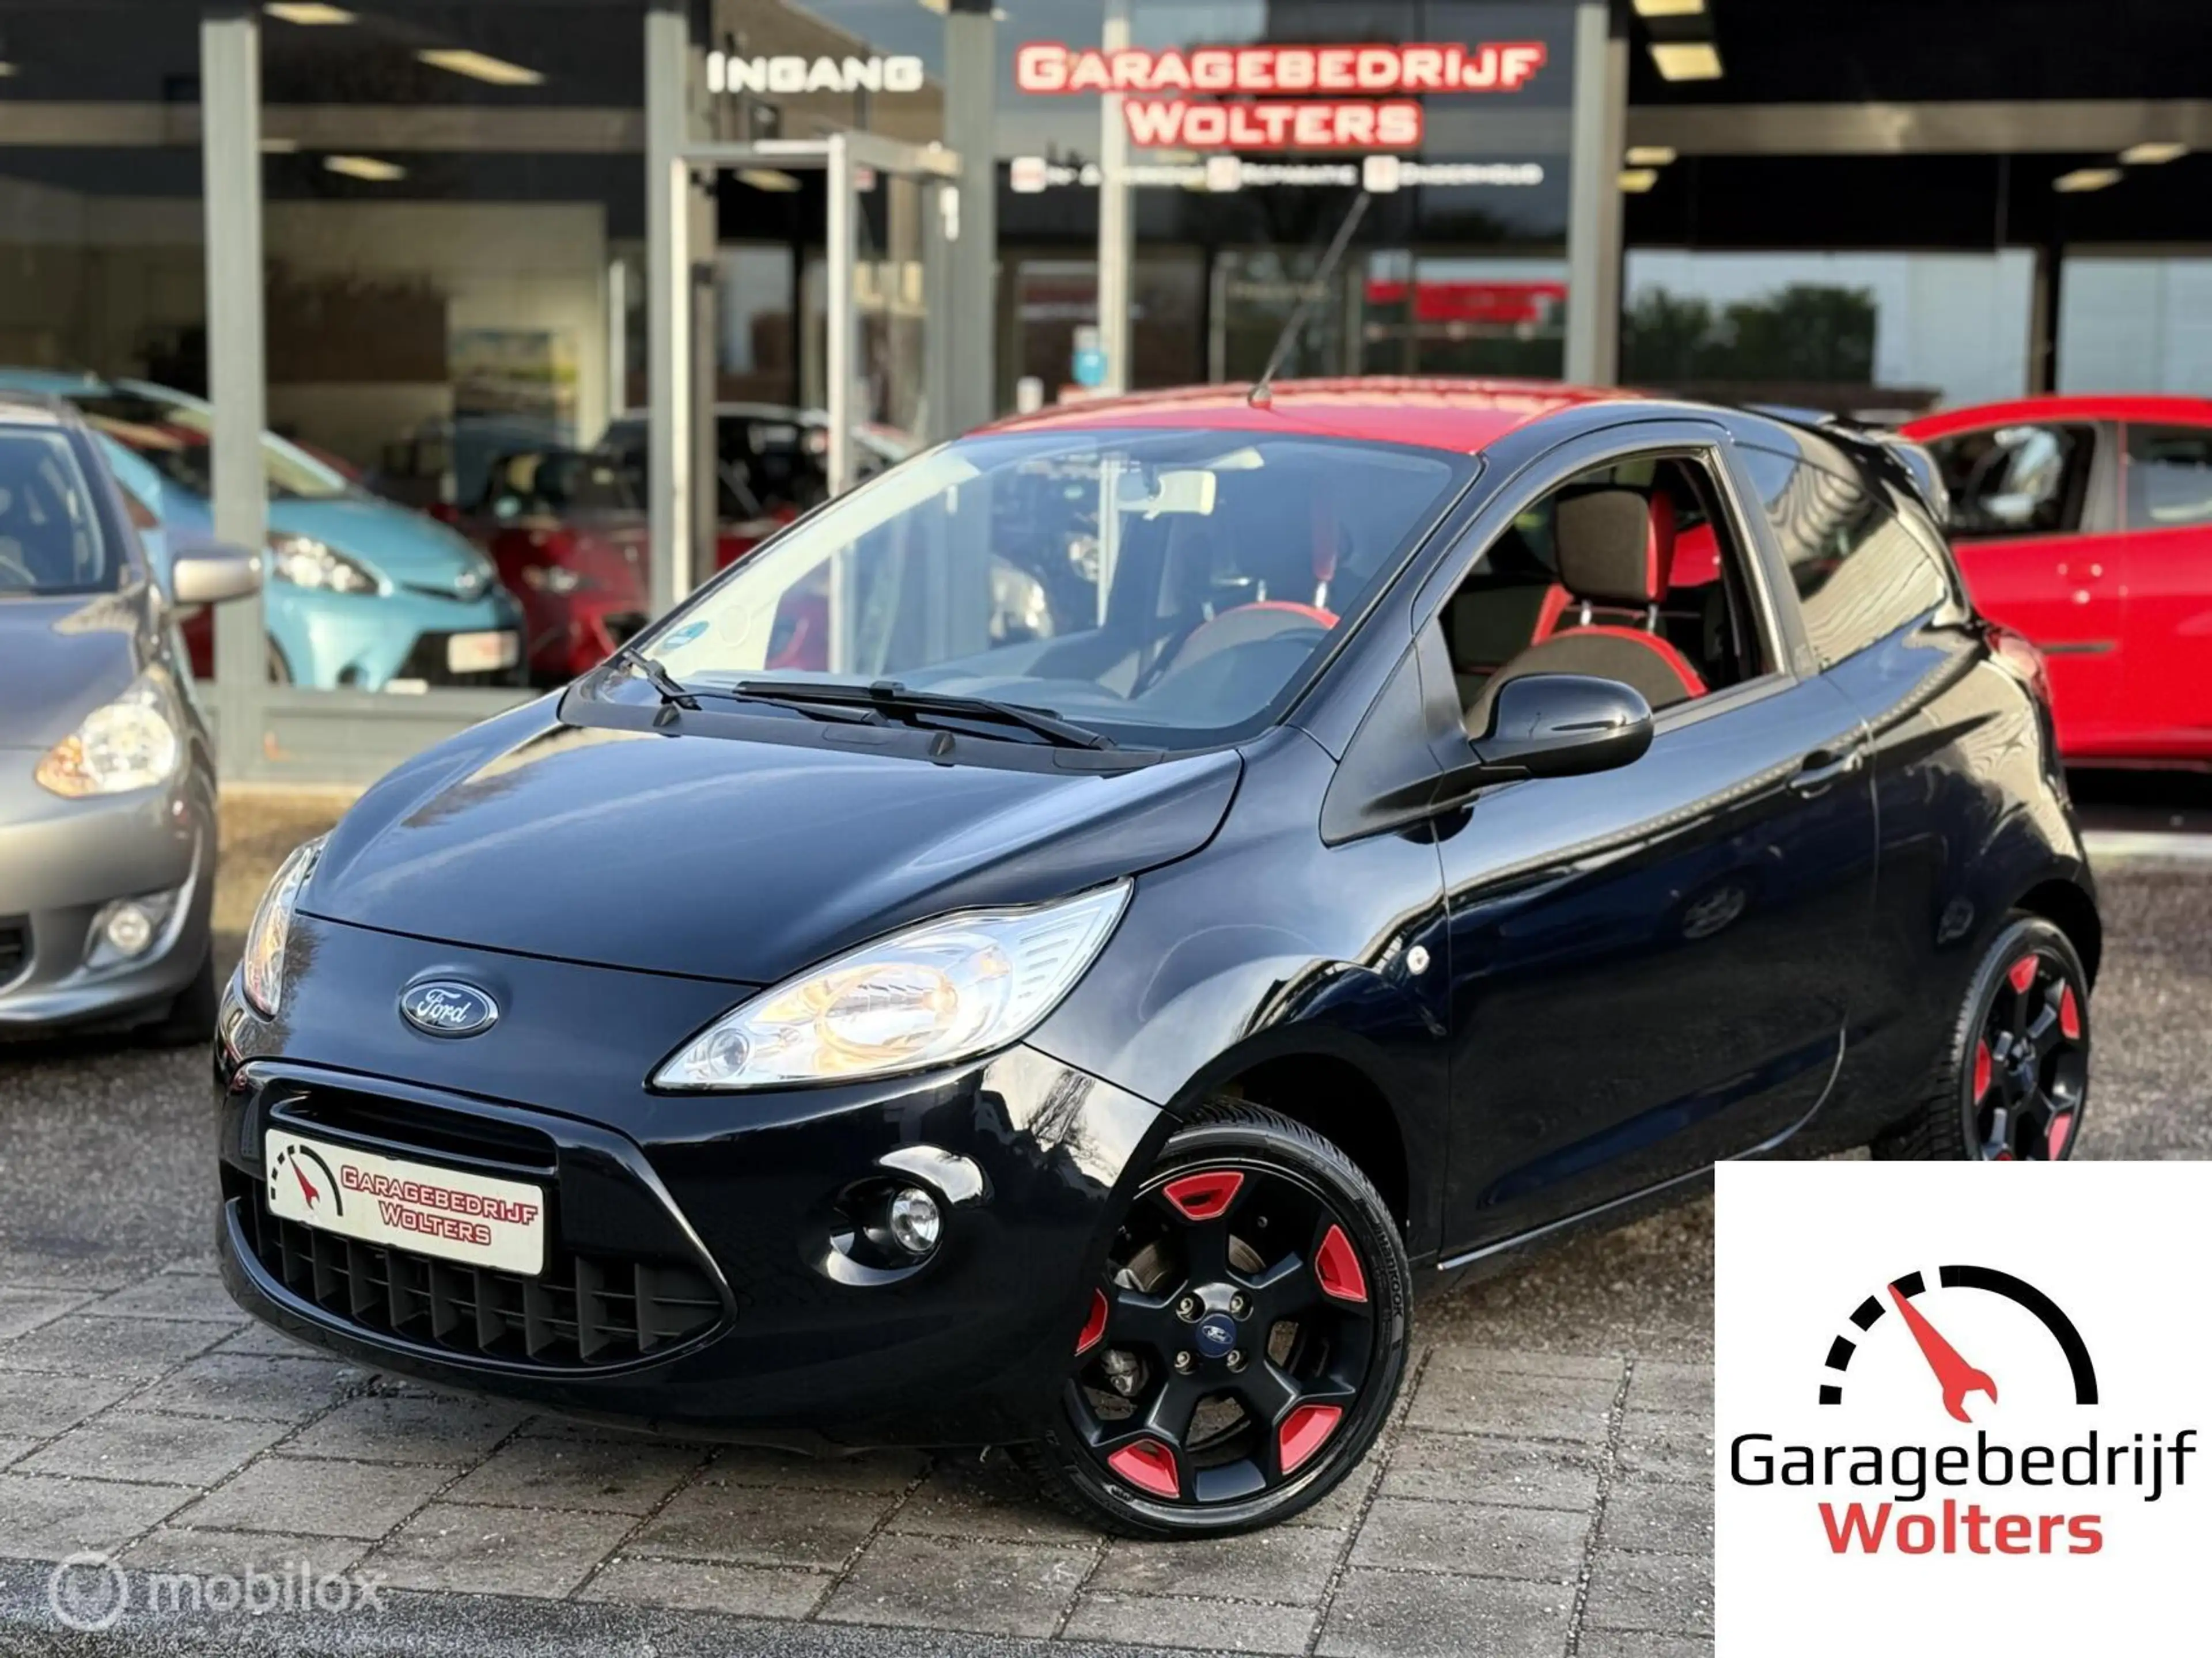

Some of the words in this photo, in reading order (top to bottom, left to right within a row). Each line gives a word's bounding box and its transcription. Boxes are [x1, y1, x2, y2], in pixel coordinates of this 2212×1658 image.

[707, 51, 923, 93] INGANG
[1016, 42, 1546, 93] GARAGEBEDRIJF
[1126, 98, 1423, 149] WOLTERS
[417, 987, 471, 1023] Ford
[341, 1164, 539, 1225] GARAGEBEDRIJF
[378, 1200, 492, 1245] WOLTERS
